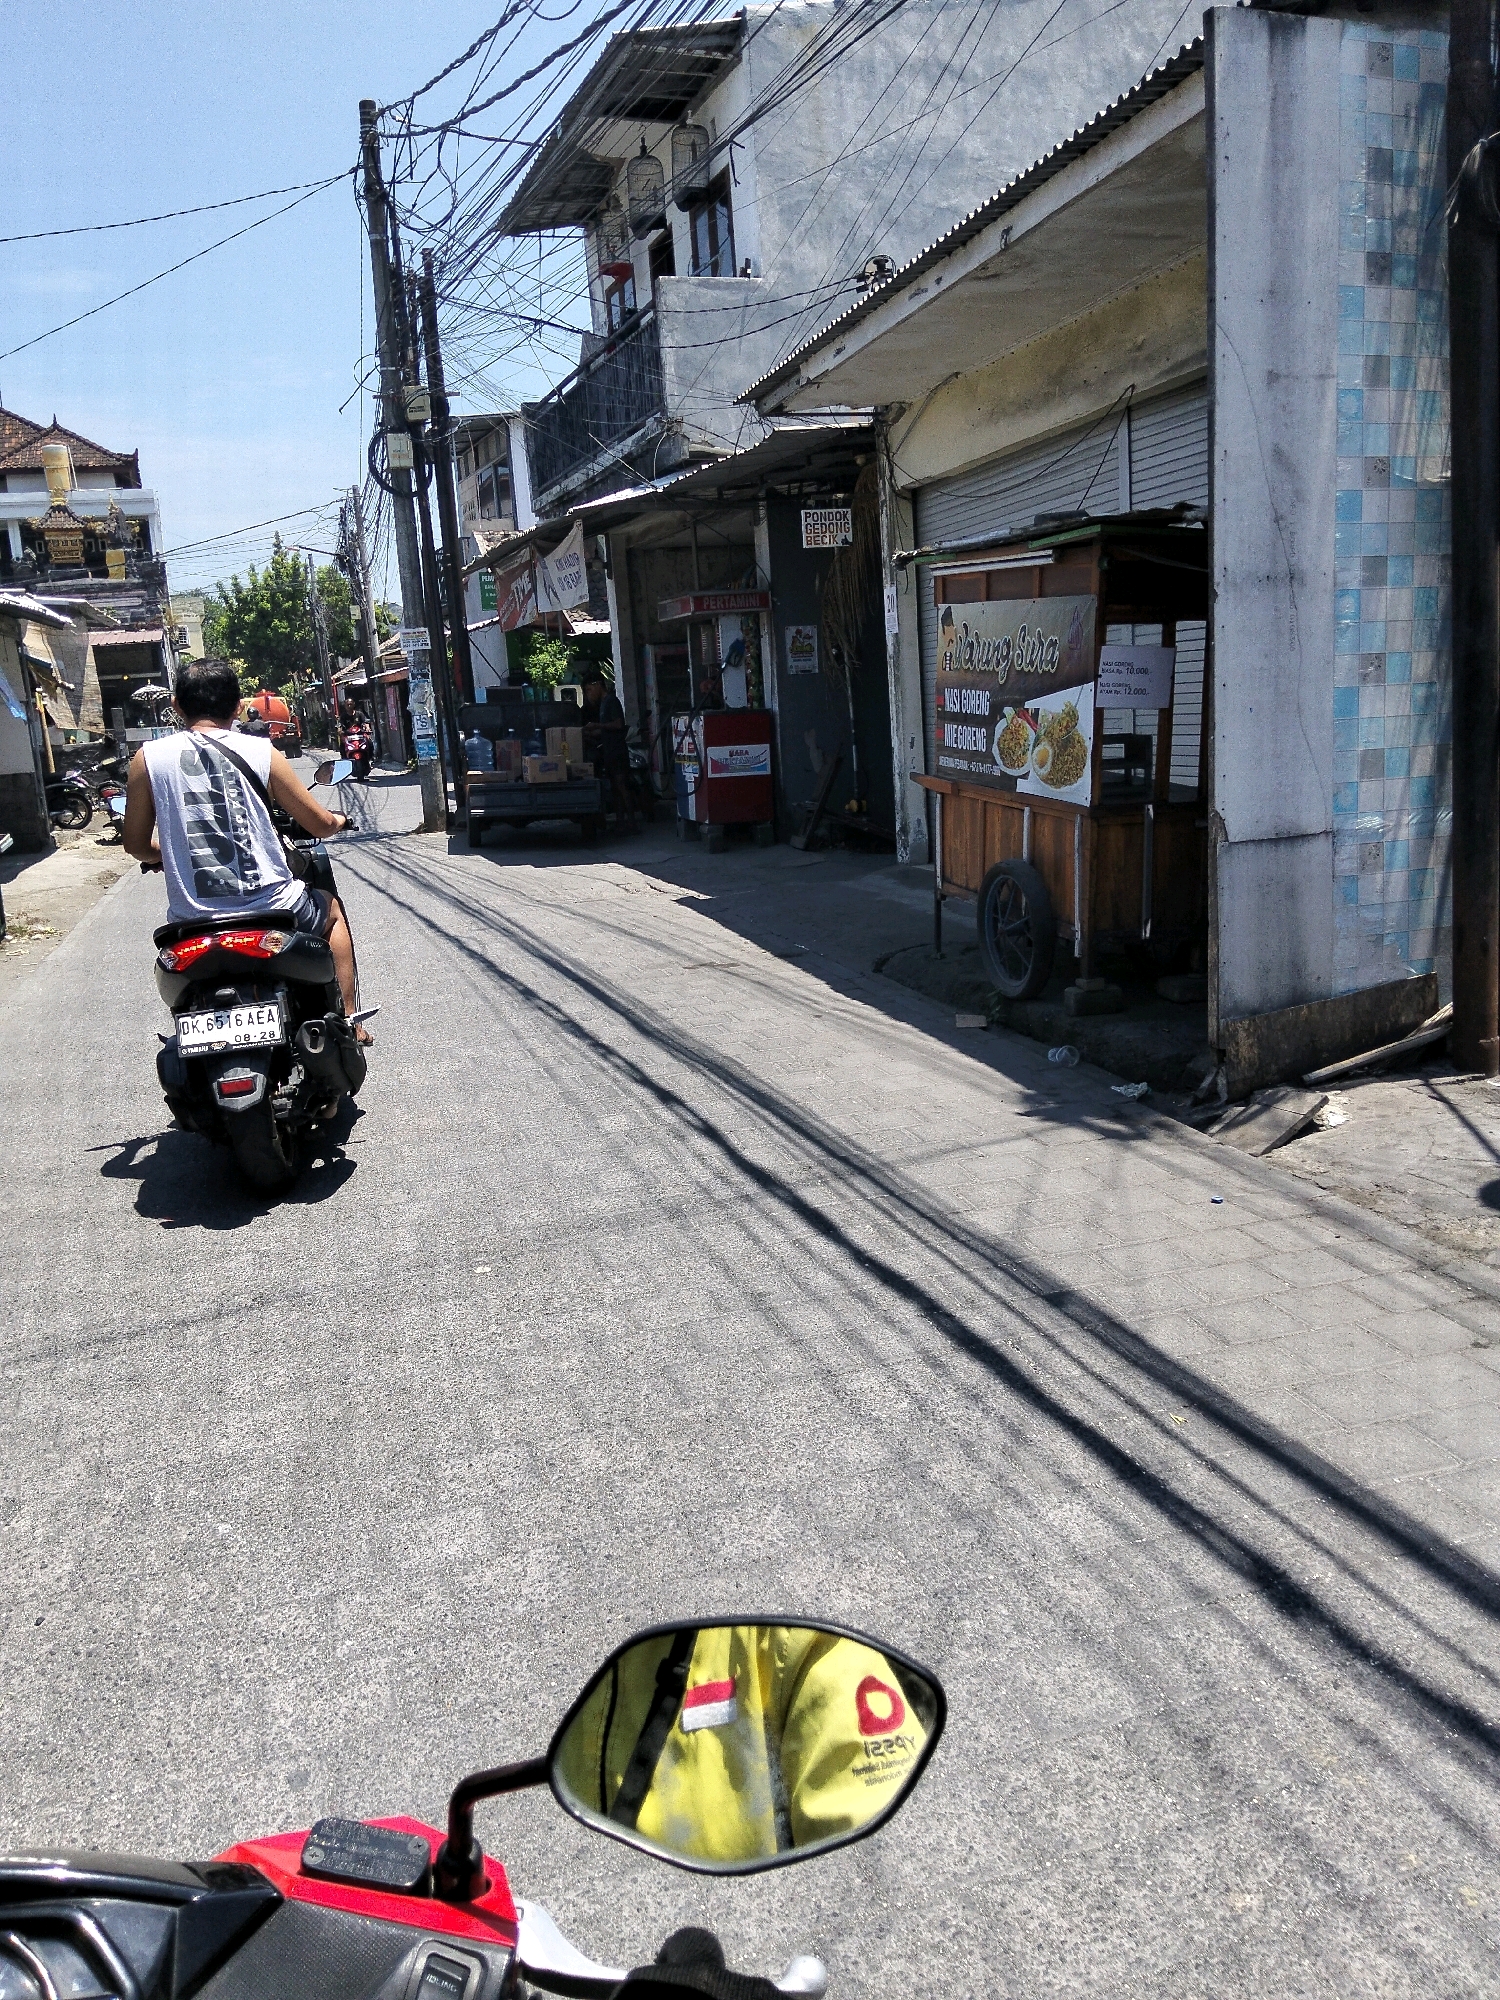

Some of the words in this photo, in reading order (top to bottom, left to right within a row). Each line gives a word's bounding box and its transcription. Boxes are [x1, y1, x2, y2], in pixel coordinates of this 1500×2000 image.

[804, 511, 850, 523] PONDOK
[805, 522, 851, 535] GEDONG
[805, 534, 838, 546] BECIK
[703, 595, 760, 610] PERTAMINI
[953, 621, 1013, 685] Warung
[1014, 623, 1060, 674] Sura
[944, 687, 961, 713] NASI
[961, 689, 990, 716] GORENG
[944, 723, 957, 748] MIE
[957, 725, 987, 752] GORENG
[247, 1008, 276, 1026] AEA
